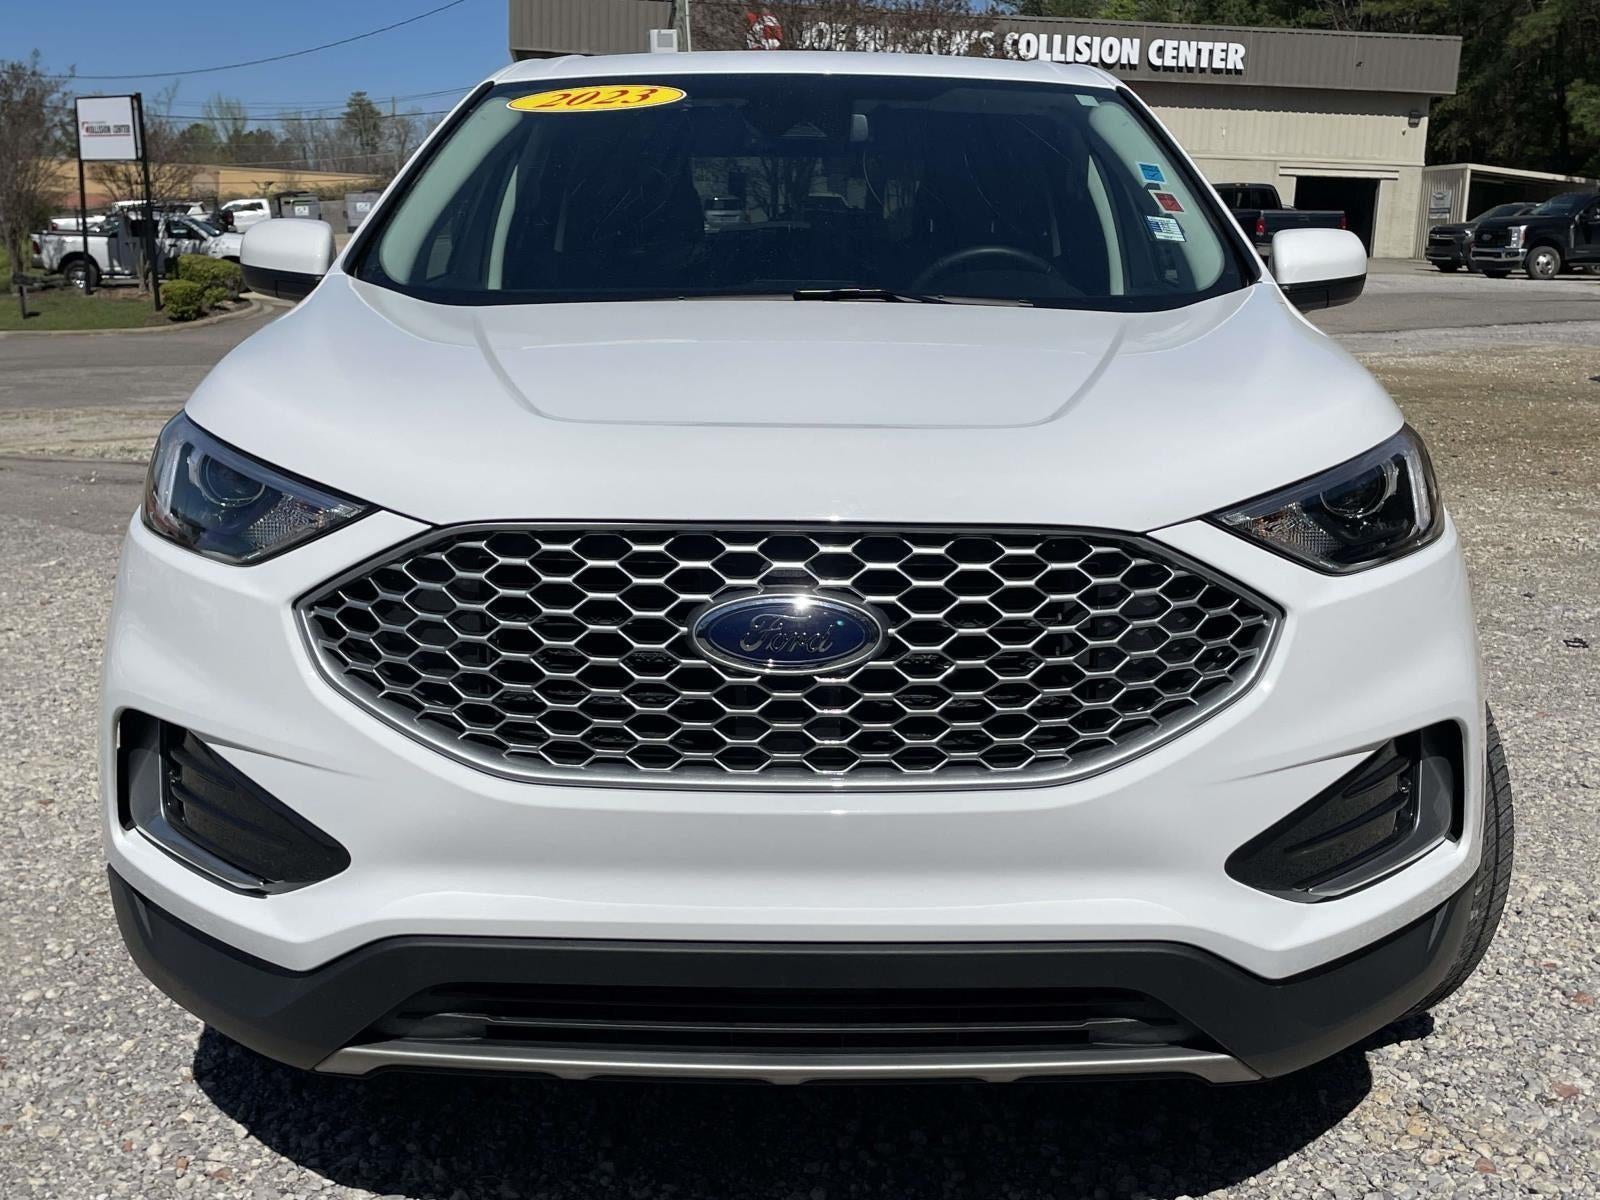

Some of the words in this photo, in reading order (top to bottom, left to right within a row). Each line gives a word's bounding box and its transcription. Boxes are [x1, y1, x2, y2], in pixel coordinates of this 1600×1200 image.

[855, 24, 995, 57] HUON'S
[1003, 32, 1141, 65] COLLISION
[1147, 38, 1247, 70] CENTER
[535, 88, 659, 108] 2023
[739, 613, 834, 653] Ford
